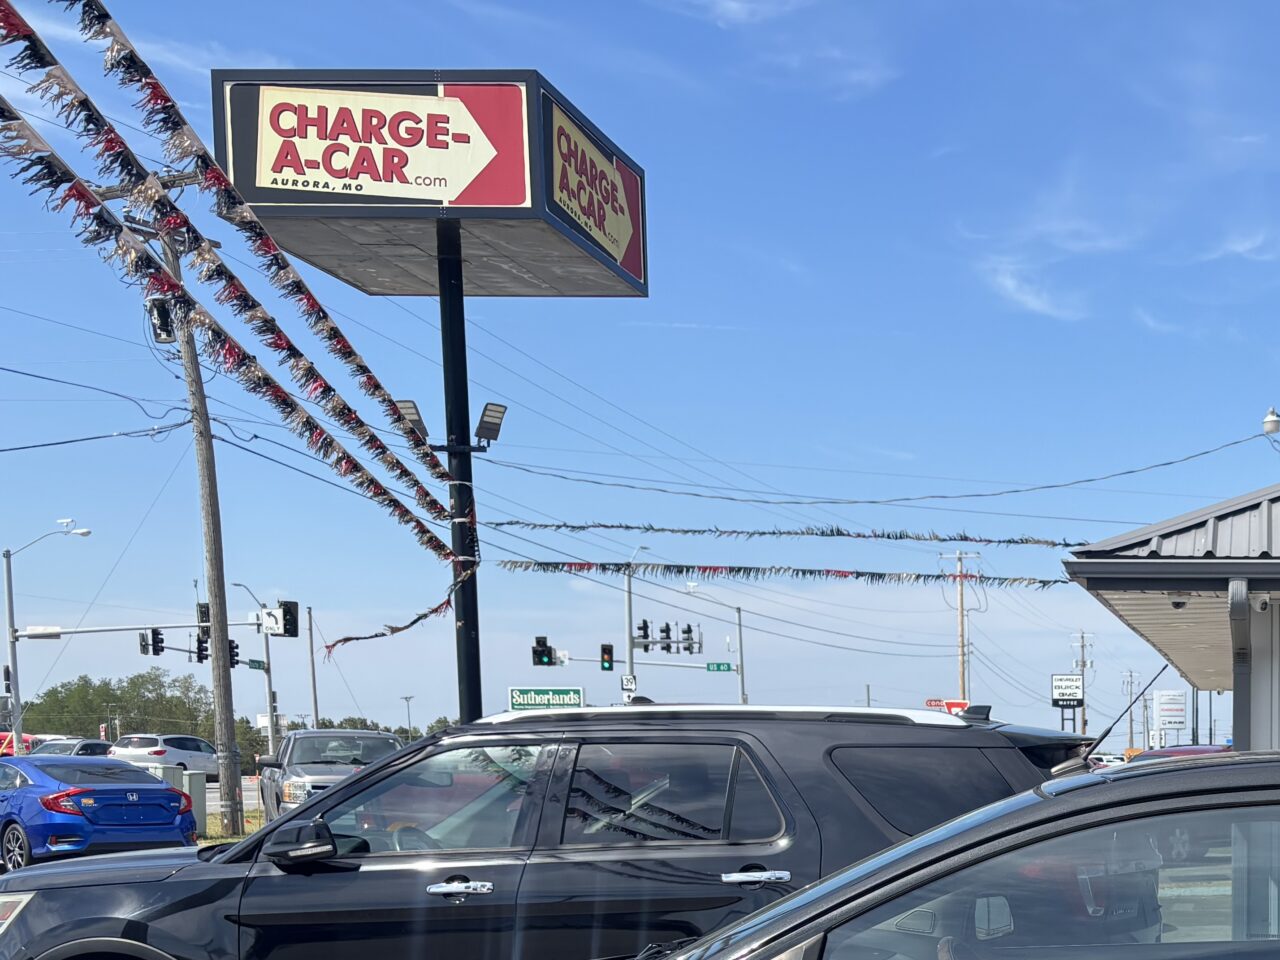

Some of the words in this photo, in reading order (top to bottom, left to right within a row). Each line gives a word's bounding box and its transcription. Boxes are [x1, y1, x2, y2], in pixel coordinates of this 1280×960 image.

[269, 101, 471, 150] CHARGE-
[557, 124, 626, 217] CHARGE-
[270, 177, 338, 191] AURORA,
[340, 182, 364, 192] MO
[708, 663, 718, 671] US
[720, 663, 728, 671] 60
[624, 677, 634, 687] 39
[512, 689, 580, 705] Sutherlands
